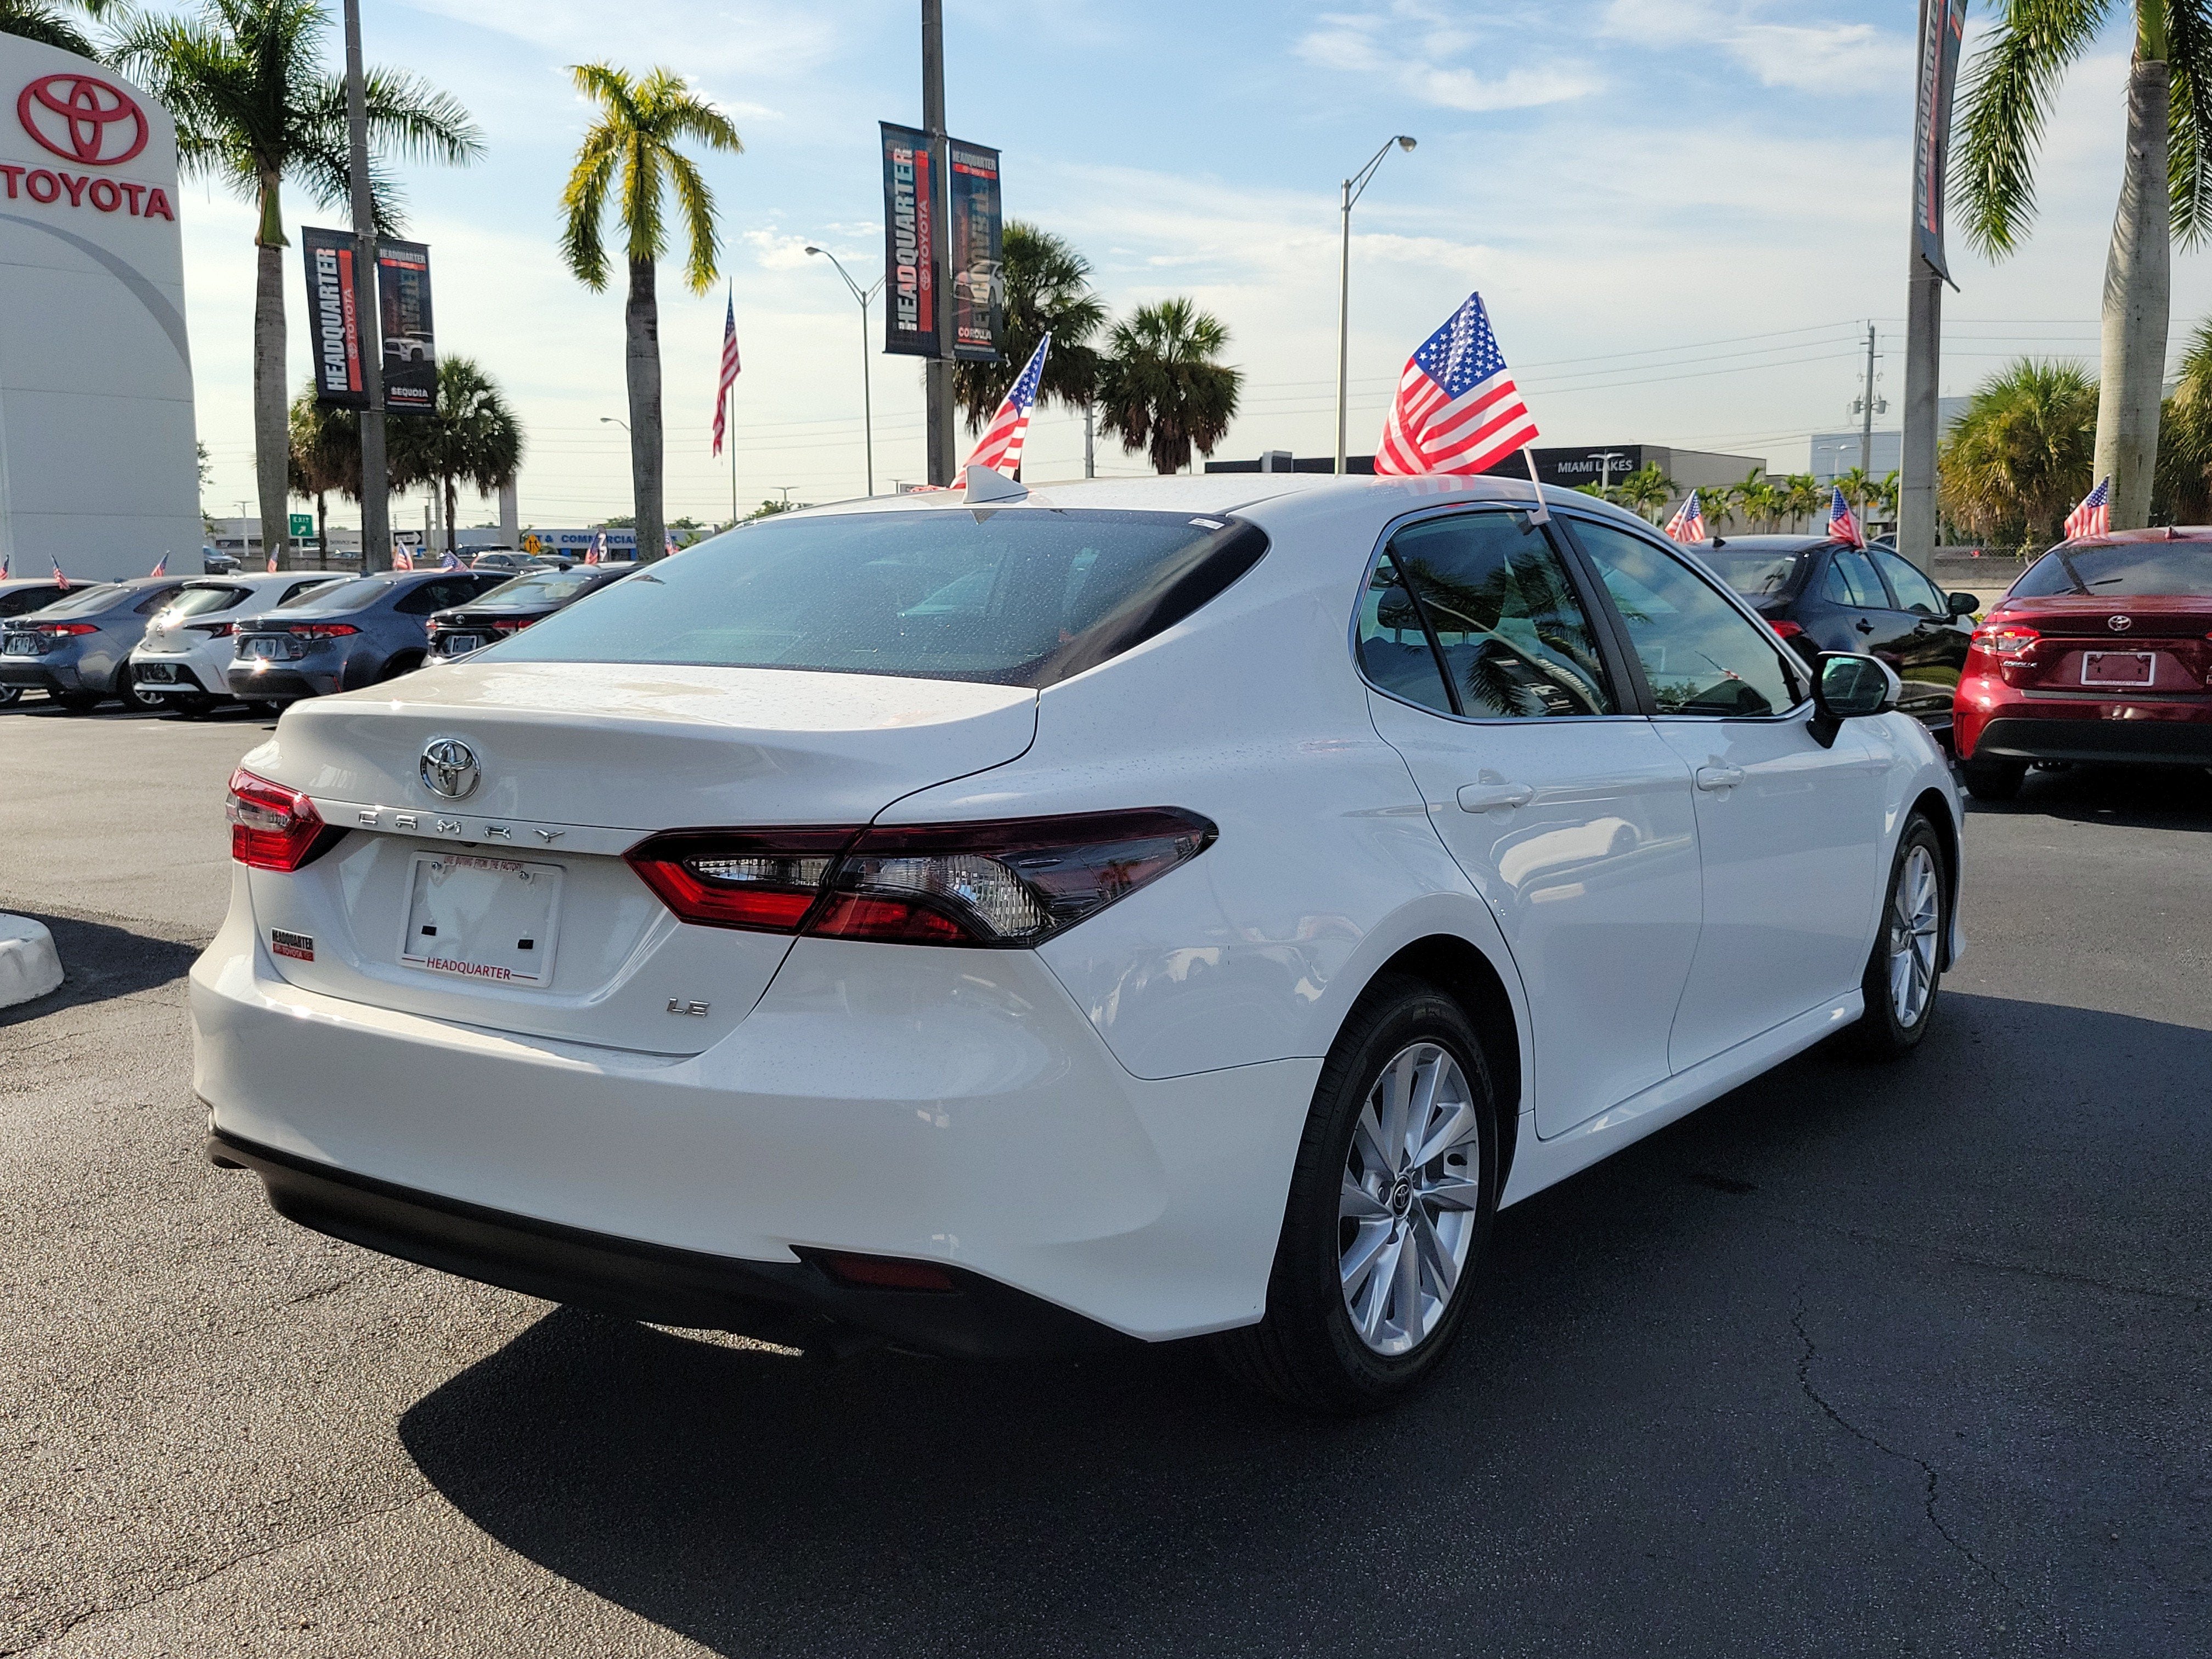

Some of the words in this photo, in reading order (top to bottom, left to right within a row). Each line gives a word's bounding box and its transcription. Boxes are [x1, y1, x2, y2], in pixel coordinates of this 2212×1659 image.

[0, 165, 175, 221] TOYOTA
[893, 148, 919, 331] HEADQUARTER
[919, 200, 930, 267] TOYOTA
[317, 248, 348, 391] HEADQUARTER
[343, 289, 357, 340] TOYOTA
[391, 386, 428, 398] SEQUOIA
[1558, 461, 1593, 473] MIAMI
[1595, 459, 1633, 471] LKES
[358, 810, 566, 843] CAMRY
[272, 929, 313, 951] HEADQUARTER
[282, 946, 303, 958] TOYOTA
[427, 957, 511, 980] HEADQUARTER
[667, 997, 710, 1017] LE
